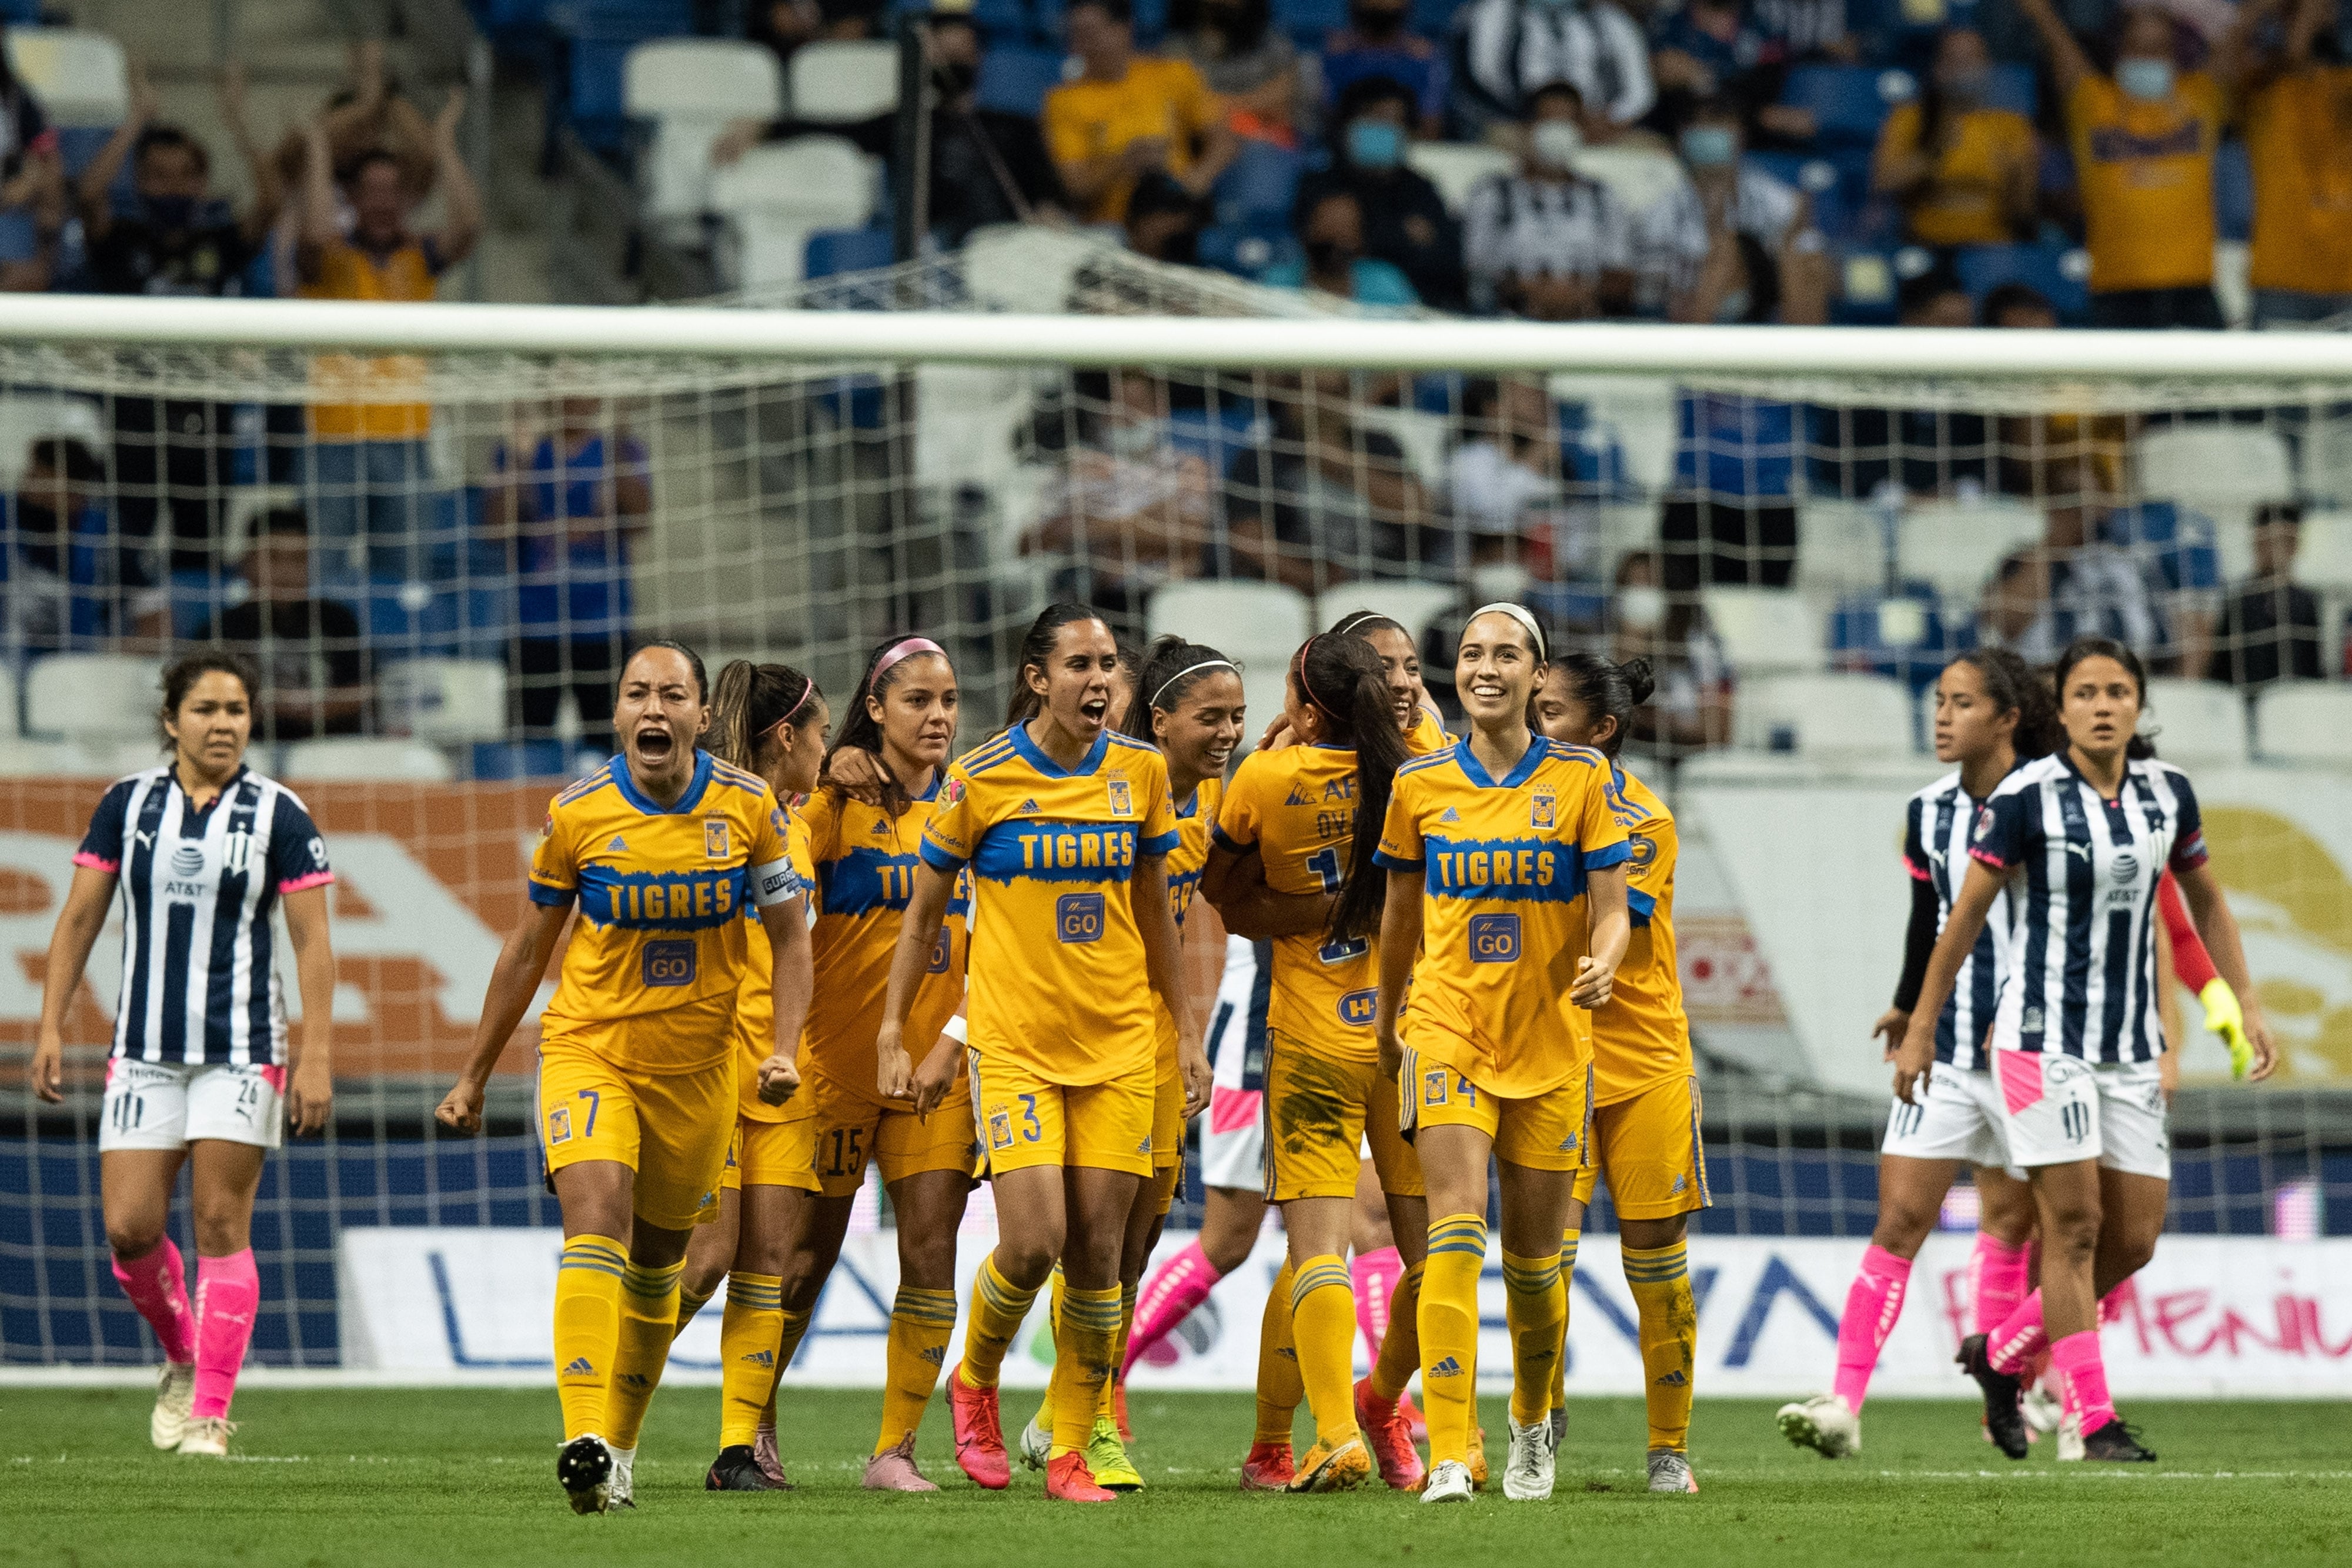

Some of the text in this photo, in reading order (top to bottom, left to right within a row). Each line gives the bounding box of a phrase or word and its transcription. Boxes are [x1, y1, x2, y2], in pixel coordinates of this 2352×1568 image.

[1018, 831, 1132, 869] TIGRES
[1437, 850, 1555, 887] TIGRES
[165, 882, 205, 895] AT&T
[607, 878, 731, 920] TIGRES
[1065, 914, 1097, 935] GO
[1477, 934, 1513, 955] GO
[652, 958, 687, 978] GO
[1457, 1075, 1476, 1108] 4
[578, 1089, 599, 1137] 7
[1018, 1094, 1041, 1142] 3
[827, 1128, 863, 1176] 15
